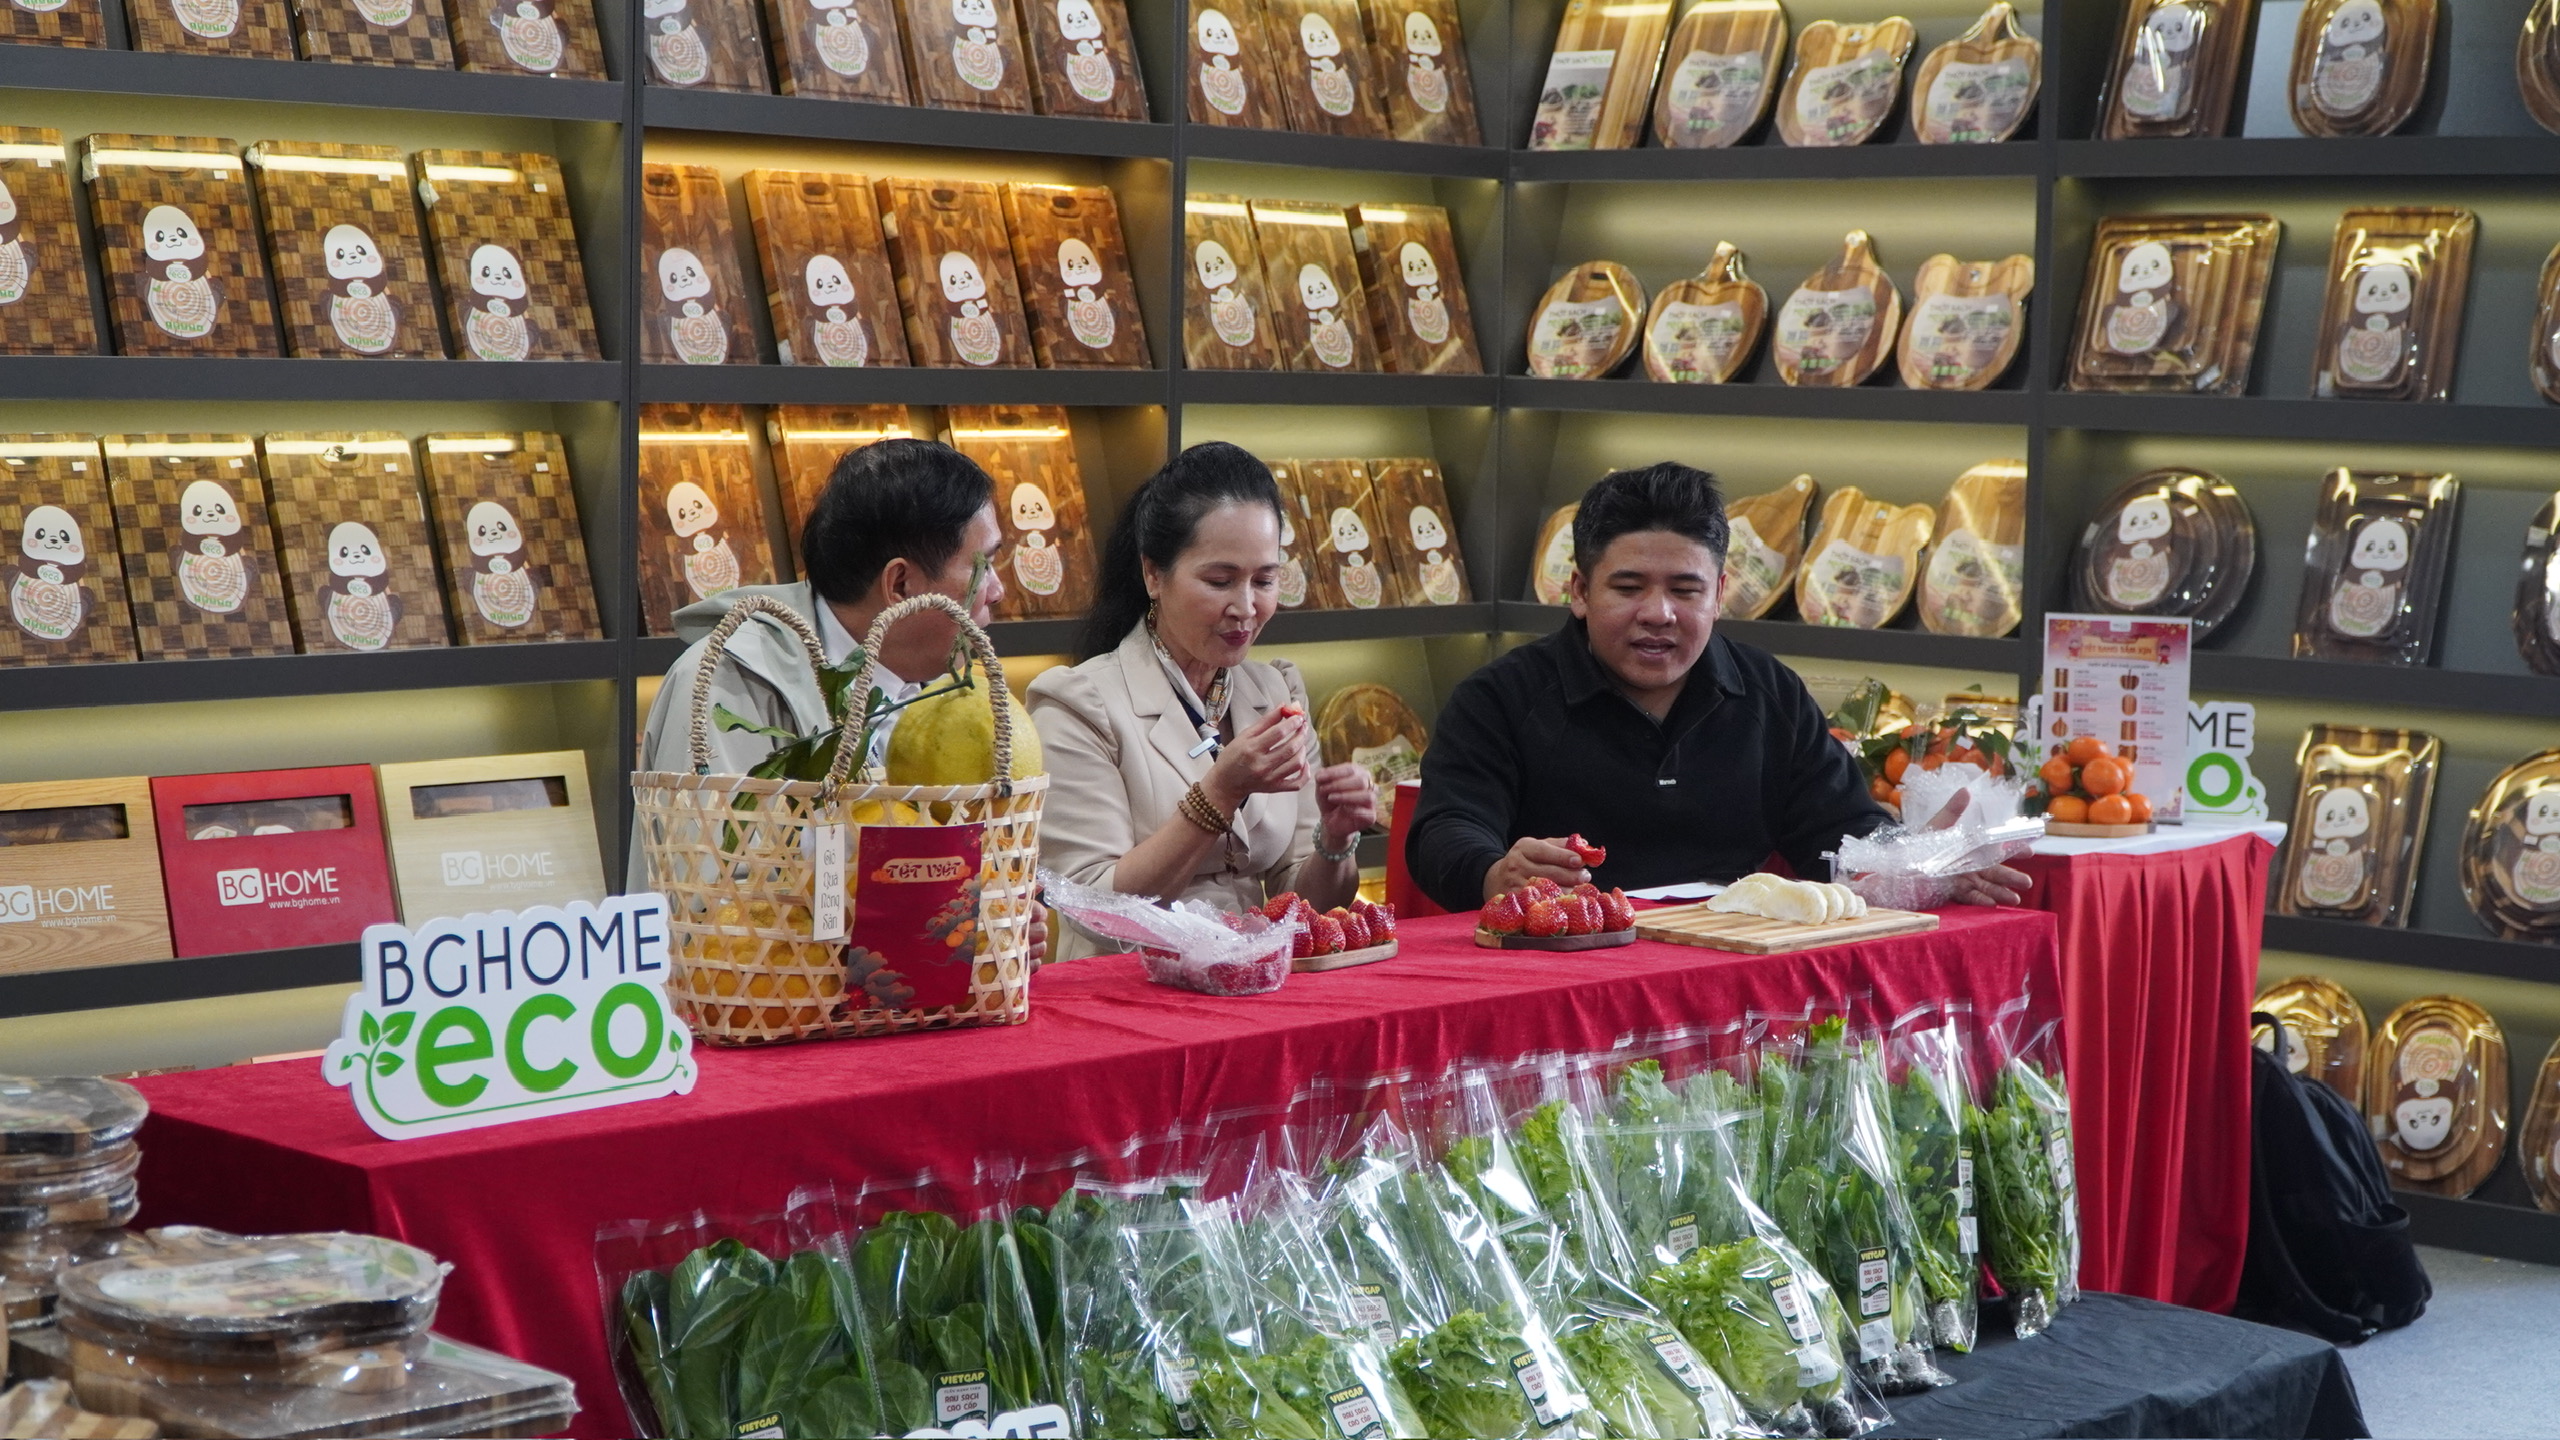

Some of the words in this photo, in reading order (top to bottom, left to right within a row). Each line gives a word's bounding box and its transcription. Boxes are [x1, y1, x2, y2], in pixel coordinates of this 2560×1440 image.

[268, 896, 341, 910] www.bghome.vn
[41, 914, 117, 929] www.bghome.vn
[379, 907, 662, 1007] BGHOME
[415, 982, 664, 1107] eco
[1860, 1249, 1886, 1261] VIETGAP
[940, 1371, 985, 1385] VIETGAP
[944, 1395, 959, 1404] RAU
[1330, 1386, 1364, 1404] VIETGAP
[946, 1404, 962, 1413] CAO
[738, 1414, 779, 1434] VIETGAP
